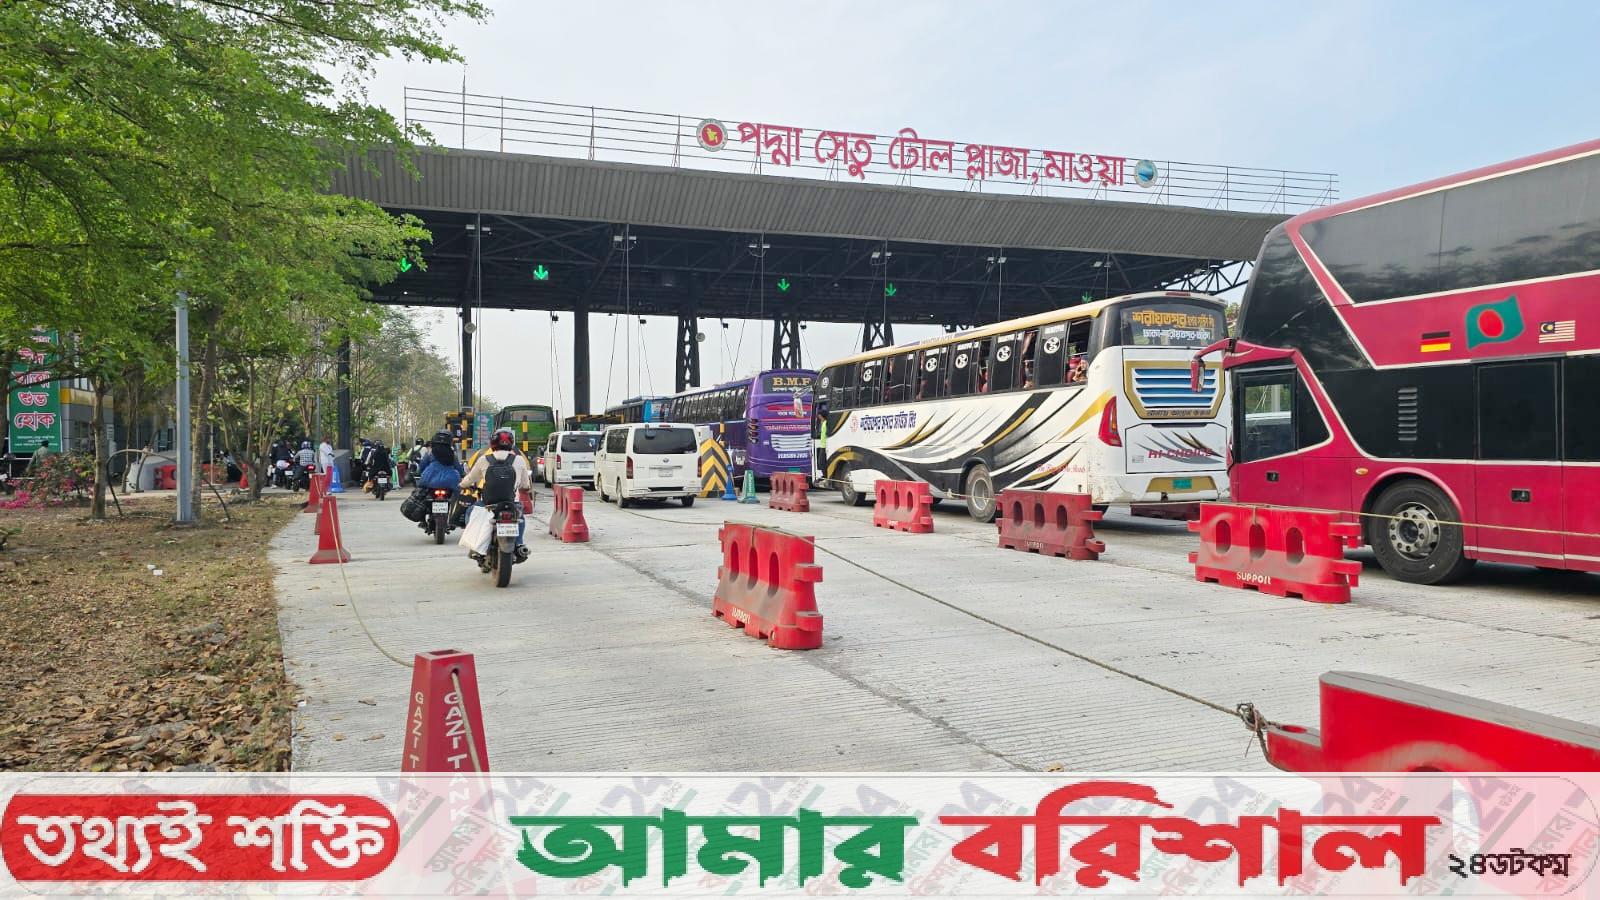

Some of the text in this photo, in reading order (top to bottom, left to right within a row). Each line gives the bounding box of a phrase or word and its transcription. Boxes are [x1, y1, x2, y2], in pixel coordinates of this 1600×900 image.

[737, 121, 804, 168] পদ্মা
[814, 130, 877, 181] সেতু
[888, 127, 955, 174] টোল
[13, 410, 57, 432] হোক
[17, 391, 49, 407] শুভ
[412, 691, 425, 750] GAZI
[443, 690, 467, 750] GAZI
